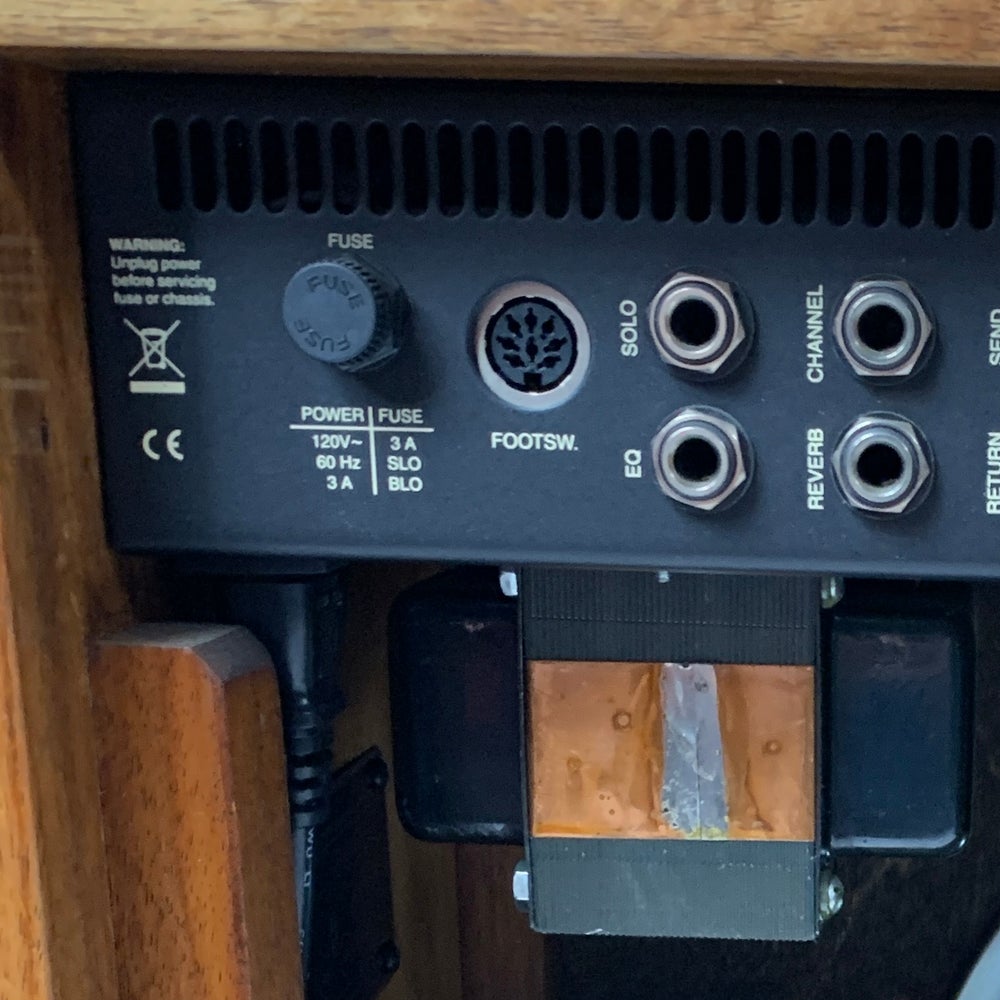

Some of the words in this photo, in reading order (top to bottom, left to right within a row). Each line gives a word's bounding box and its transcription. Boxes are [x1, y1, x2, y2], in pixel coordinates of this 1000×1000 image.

[109, 238, 186, 252] WARNING:
[327, 233, 374, 249] FUSE
[110, 256, 159, 273] Unplug
[161, 259, 201, 272] power
[112, 273, 155, 288] before
[157, 274, 216, 292] servicing
[306, 274, 365, 310] FUSE
[145, 294, 159, 305] or
[293, 318, 352, 352] FUSE
[619, 300, 639, 357] SOLO
[805, 284, 824, 384] CHANNEL
[301, 406, 365, 422] POWER
[378, 409, 424, 424] FUSE
[490, 432, 579, 451] FOOTSW.
[315, 455, 337, 469] 60
[339, 455, 362, 470] Hz
[387, 456, 422, 471] SLO
[624, 449, 642, 478] EQ
[807, 427, 825, 510] REVERB
[326, 475, 338, 490] 3
[340, 475, 353, 490] A
[388, 476, 423, 492] BLO
